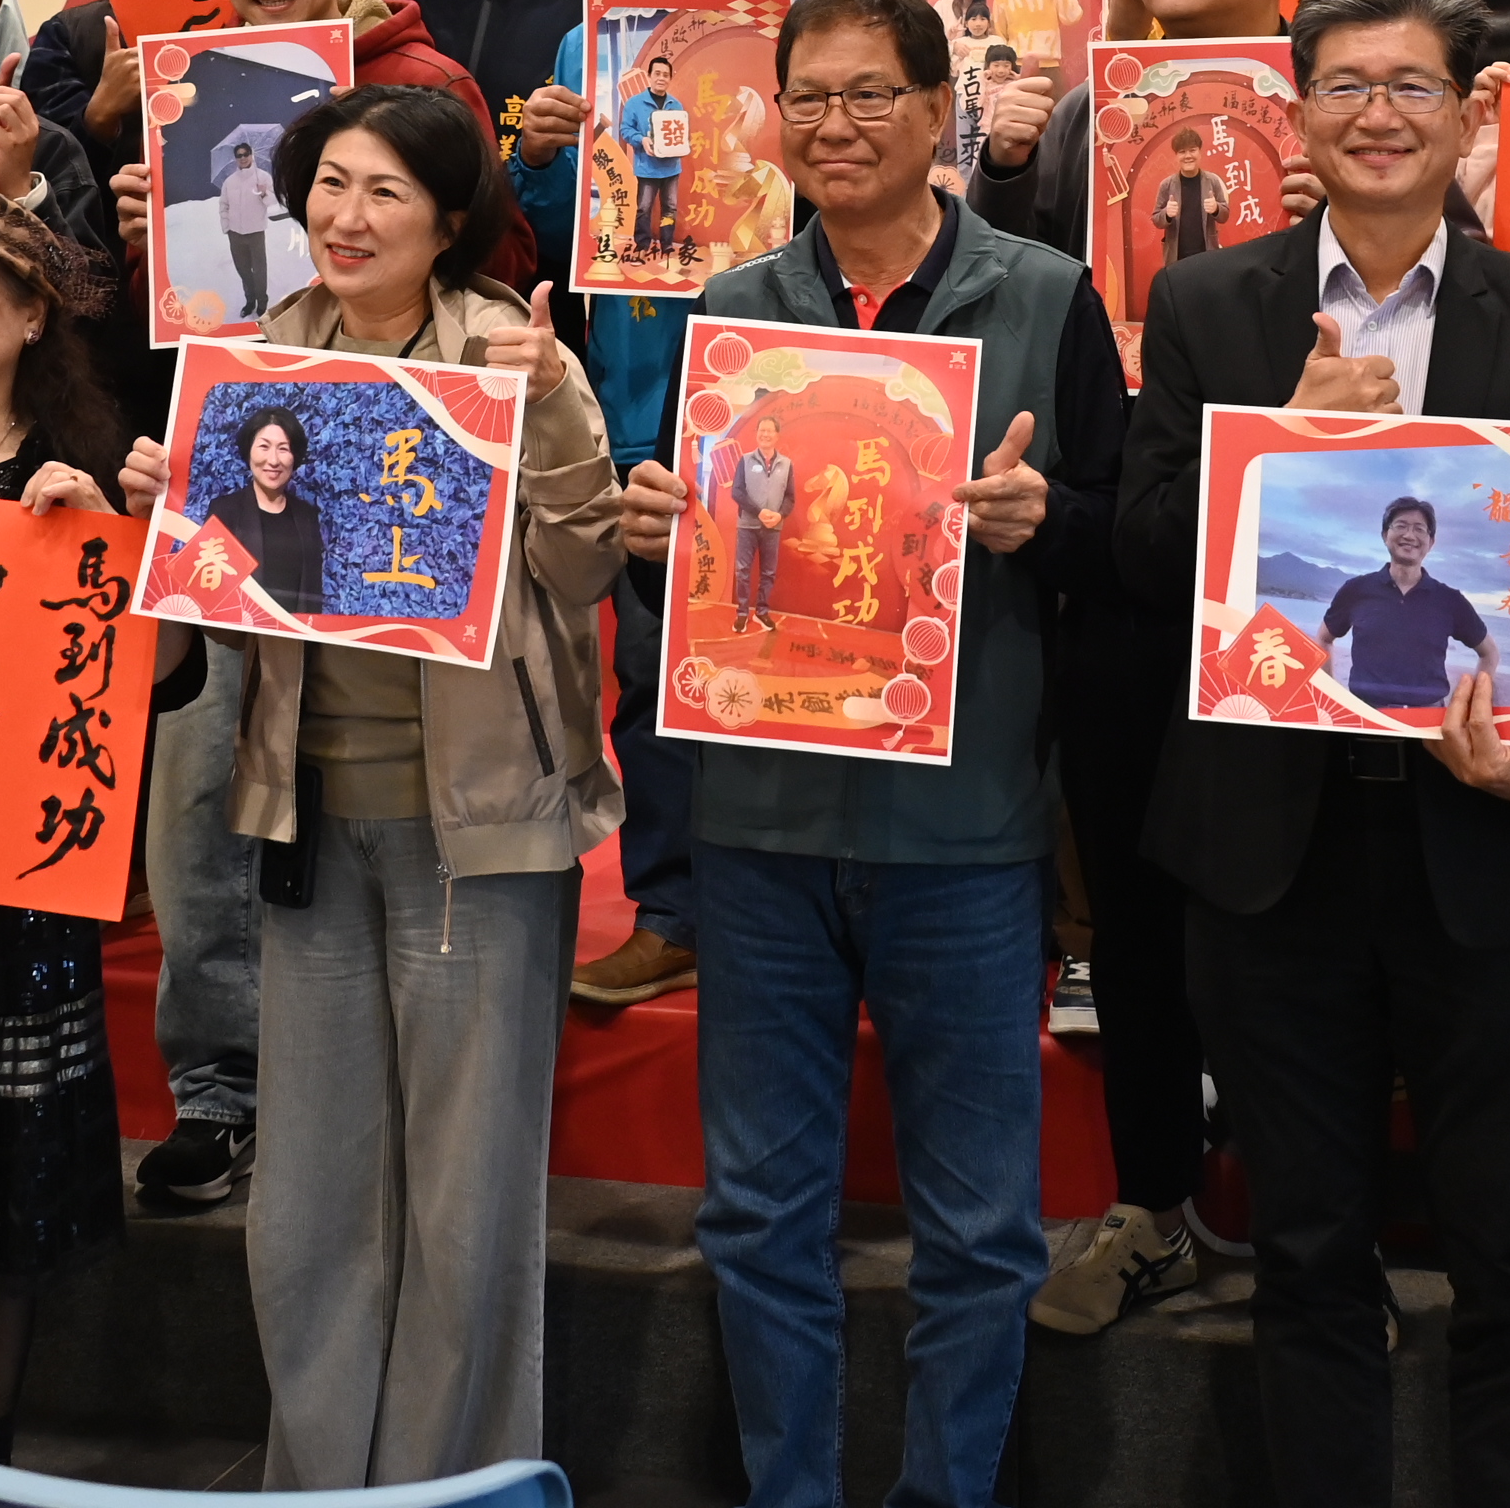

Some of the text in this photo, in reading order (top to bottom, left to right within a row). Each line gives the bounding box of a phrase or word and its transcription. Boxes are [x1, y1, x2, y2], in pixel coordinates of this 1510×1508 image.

[660, 118, 686, 147] 發
[685, 72, 732, 228] 馬到成功
[1206, 114, 1265, 227] 馬到成
[590, 234, 705, 270] 馬啟新象
[186, 536, 239, 591] 春
[359, 428, 445, 590] 馬上
[831, 436, 891, 625] 馬到成功
[15, 536, 132, 881] 馬到成功
[1246, 625, 1306, 690] 春
